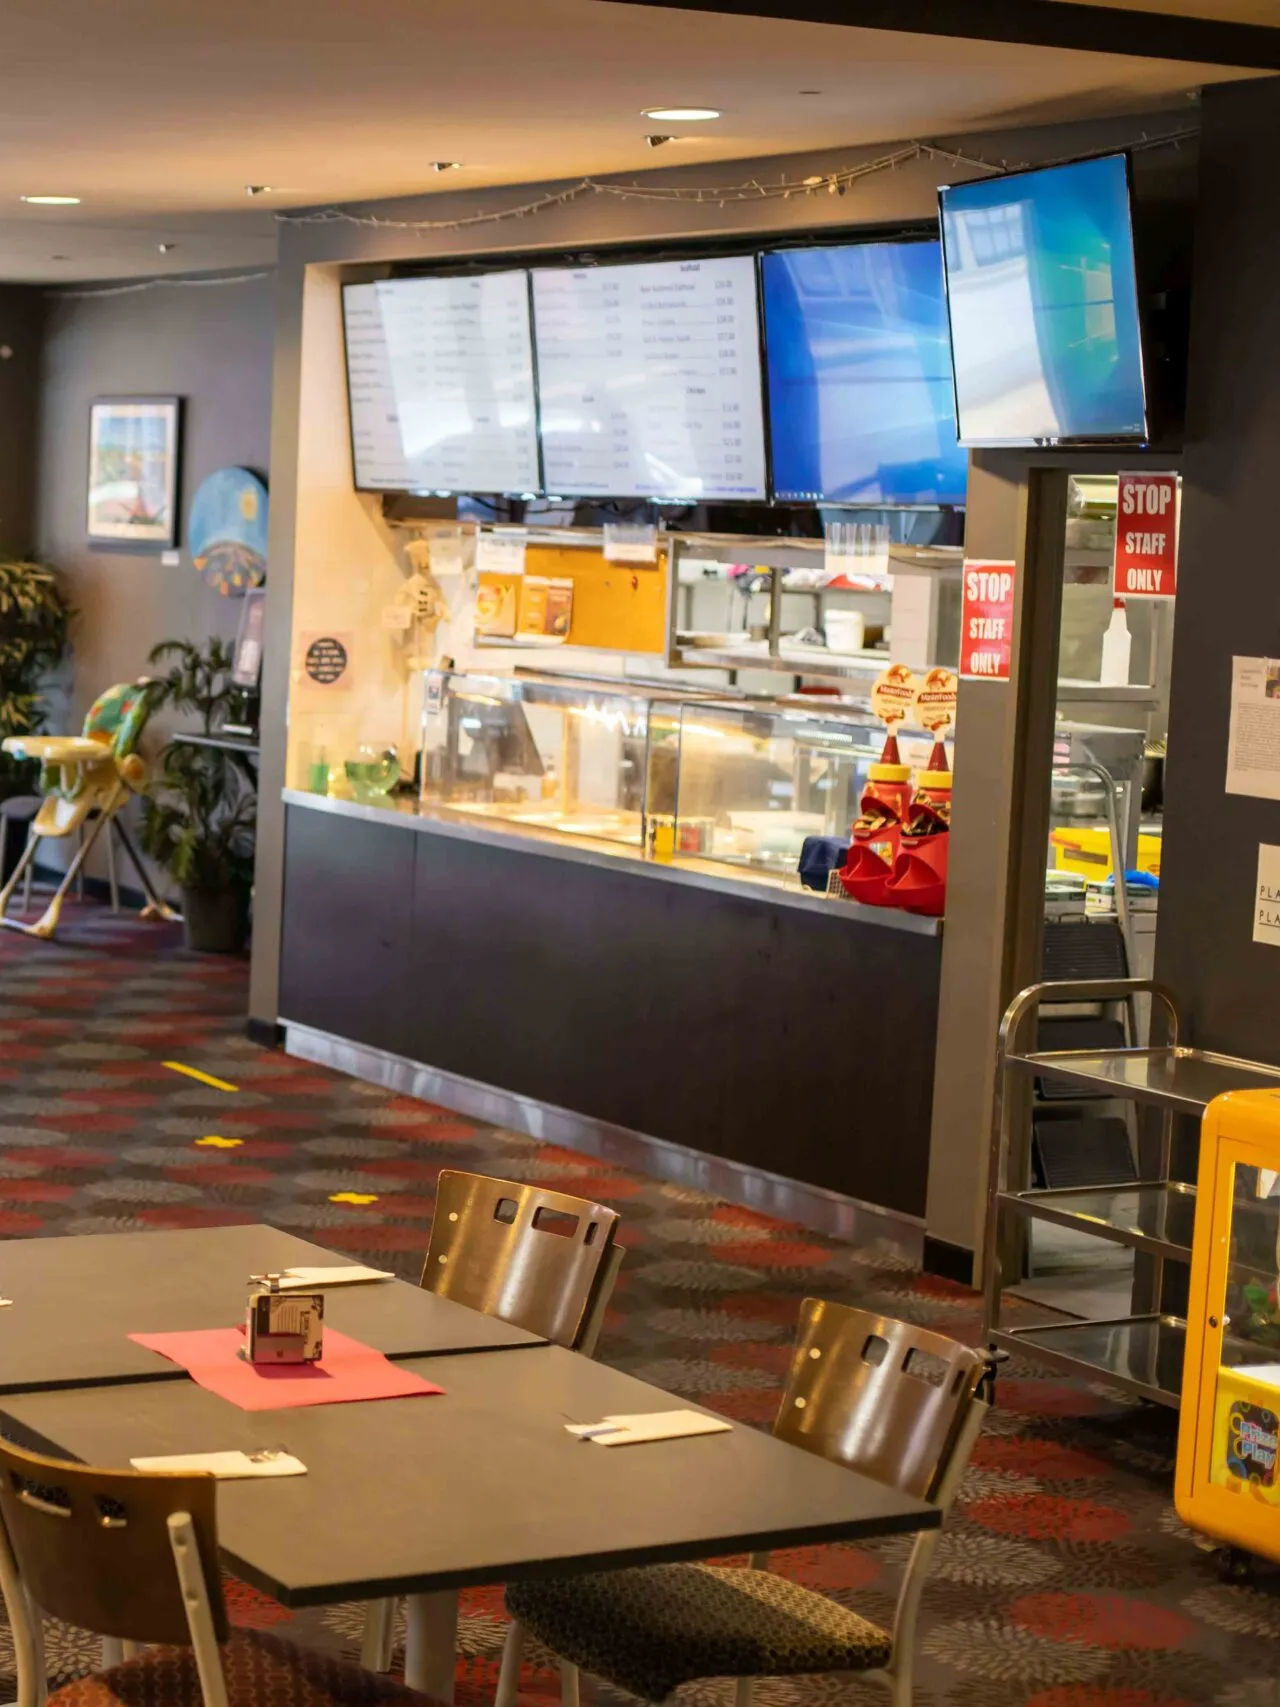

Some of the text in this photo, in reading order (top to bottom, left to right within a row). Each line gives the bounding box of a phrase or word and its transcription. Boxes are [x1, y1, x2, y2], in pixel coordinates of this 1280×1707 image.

[1122, 484, 1171, 515] STOP
[1125, 532, 1167, 555] STAFF
[967, 572, 1011, 603] STOP
[1127, 568, 1162, 591] ONLY
[969, 618, 1005, 640] STAFF
[971, 652, 1001, 675] ONLY
[1240, 1421, 1278, 1450] Prize
[1242, 1440, 1275, 1470] Play
